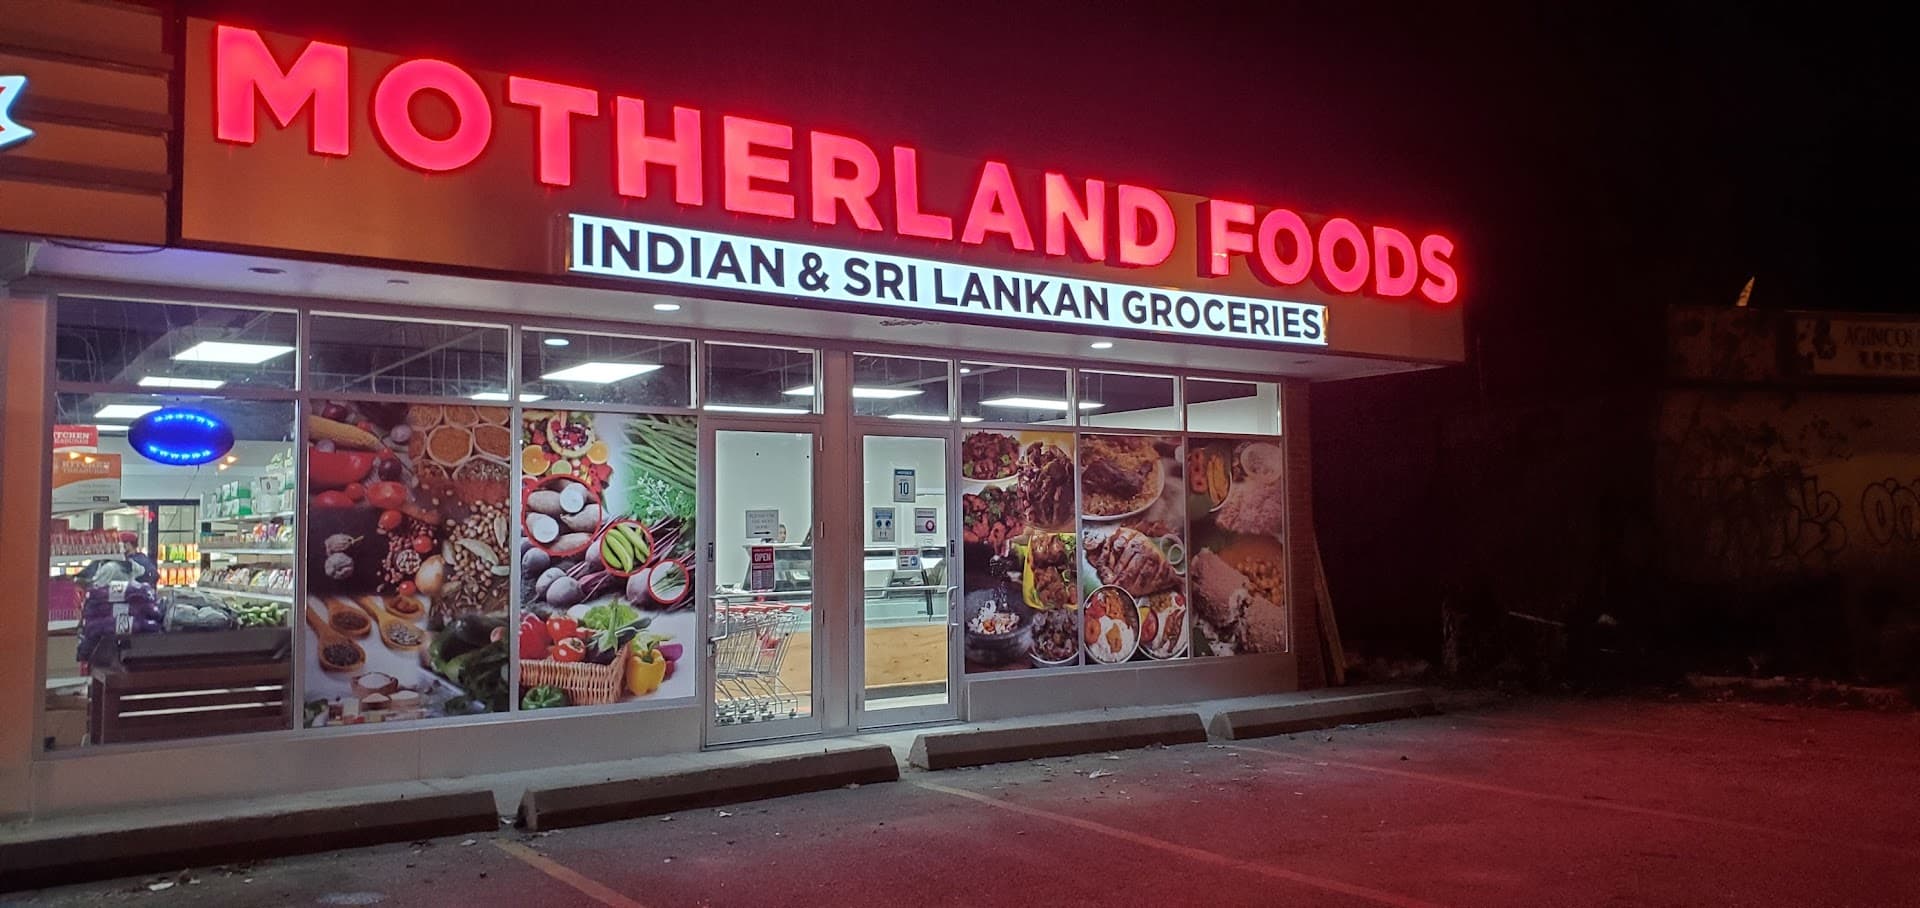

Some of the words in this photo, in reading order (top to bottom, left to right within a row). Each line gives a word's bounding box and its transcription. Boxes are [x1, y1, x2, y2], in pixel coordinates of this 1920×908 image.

[216, 24, 1176, 267] MOTHERLAND
[1208, 199, 1458, 304] FOODS
[581, 223, 786, 288] INDIAN
[798, 252, 830, 293] &
[844, 257, 919, 303] SRI
[933, 268, 1111, 322] LANKAN
[1121, 290, 1321, 340] GROCERIES
[898, 481, 910, 495] 10
[754, 552, 772, 562] OPEN
